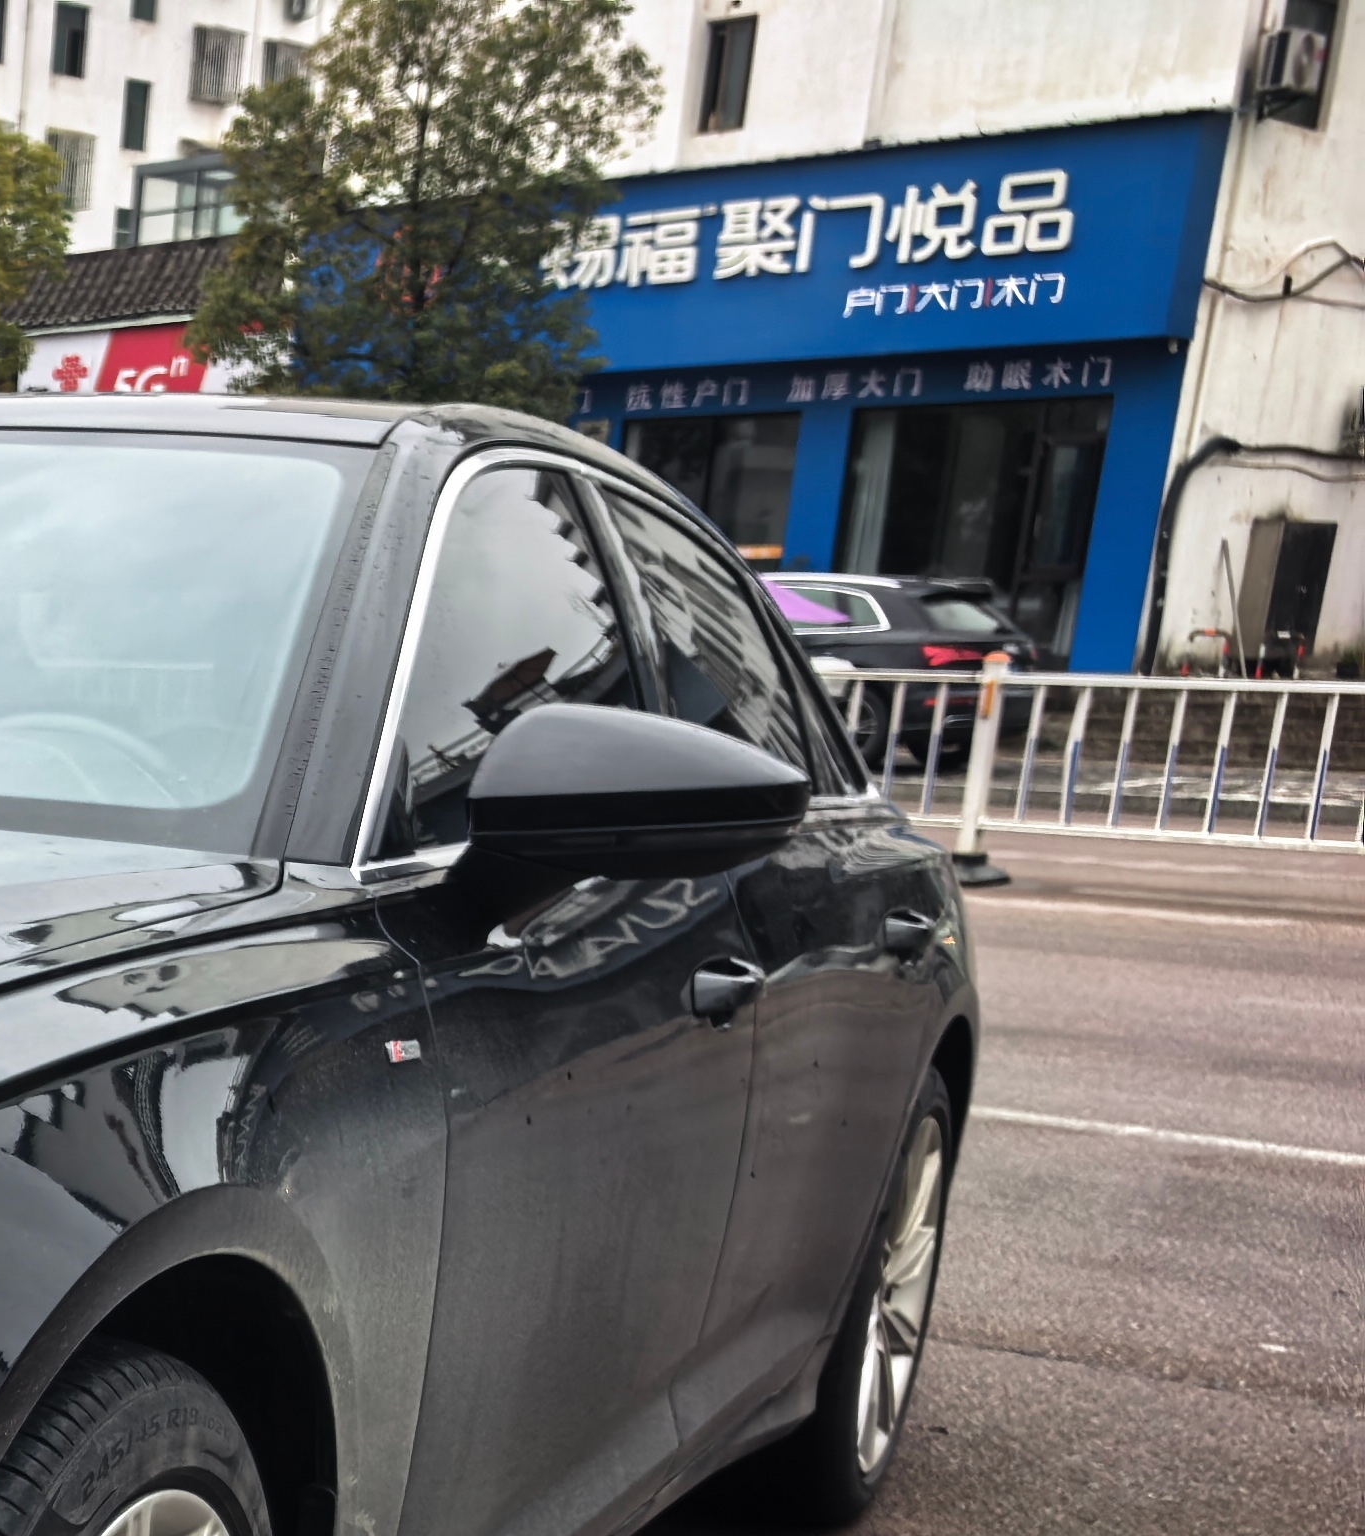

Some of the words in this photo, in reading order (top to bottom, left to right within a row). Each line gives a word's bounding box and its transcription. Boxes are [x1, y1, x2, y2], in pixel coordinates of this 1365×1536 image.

[713, 168, 1074, 281] 聚门悦品
[786, 366, 925, 403] 加厚大门
[962, 354, 1112, 394] 助眠木门
